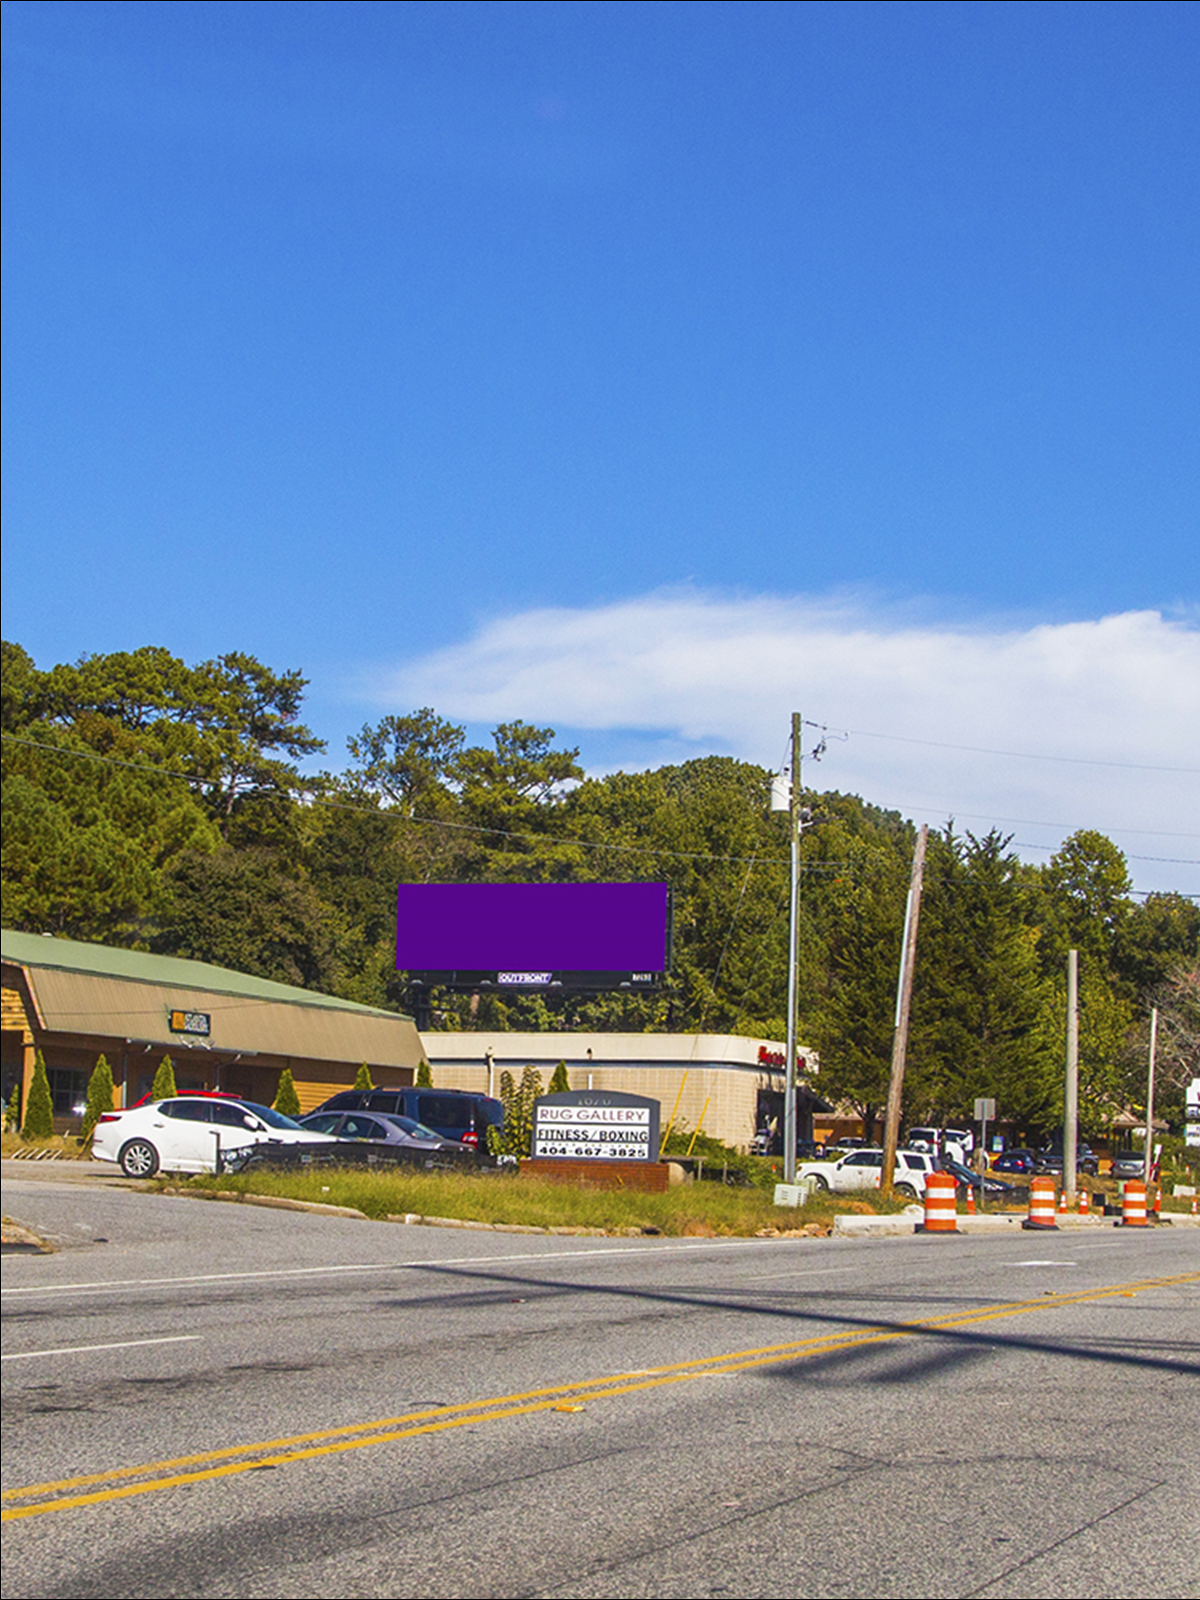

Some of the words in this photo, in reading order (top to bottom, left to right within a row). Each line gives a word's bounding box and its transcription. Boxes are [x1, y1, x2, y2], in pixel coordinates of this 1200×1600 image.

[539, 1108, 573, 1120] RUG
[576, 1109, 646, 1121] GALLERY
[539, 1147, 646, 1157] 404-667-3825
